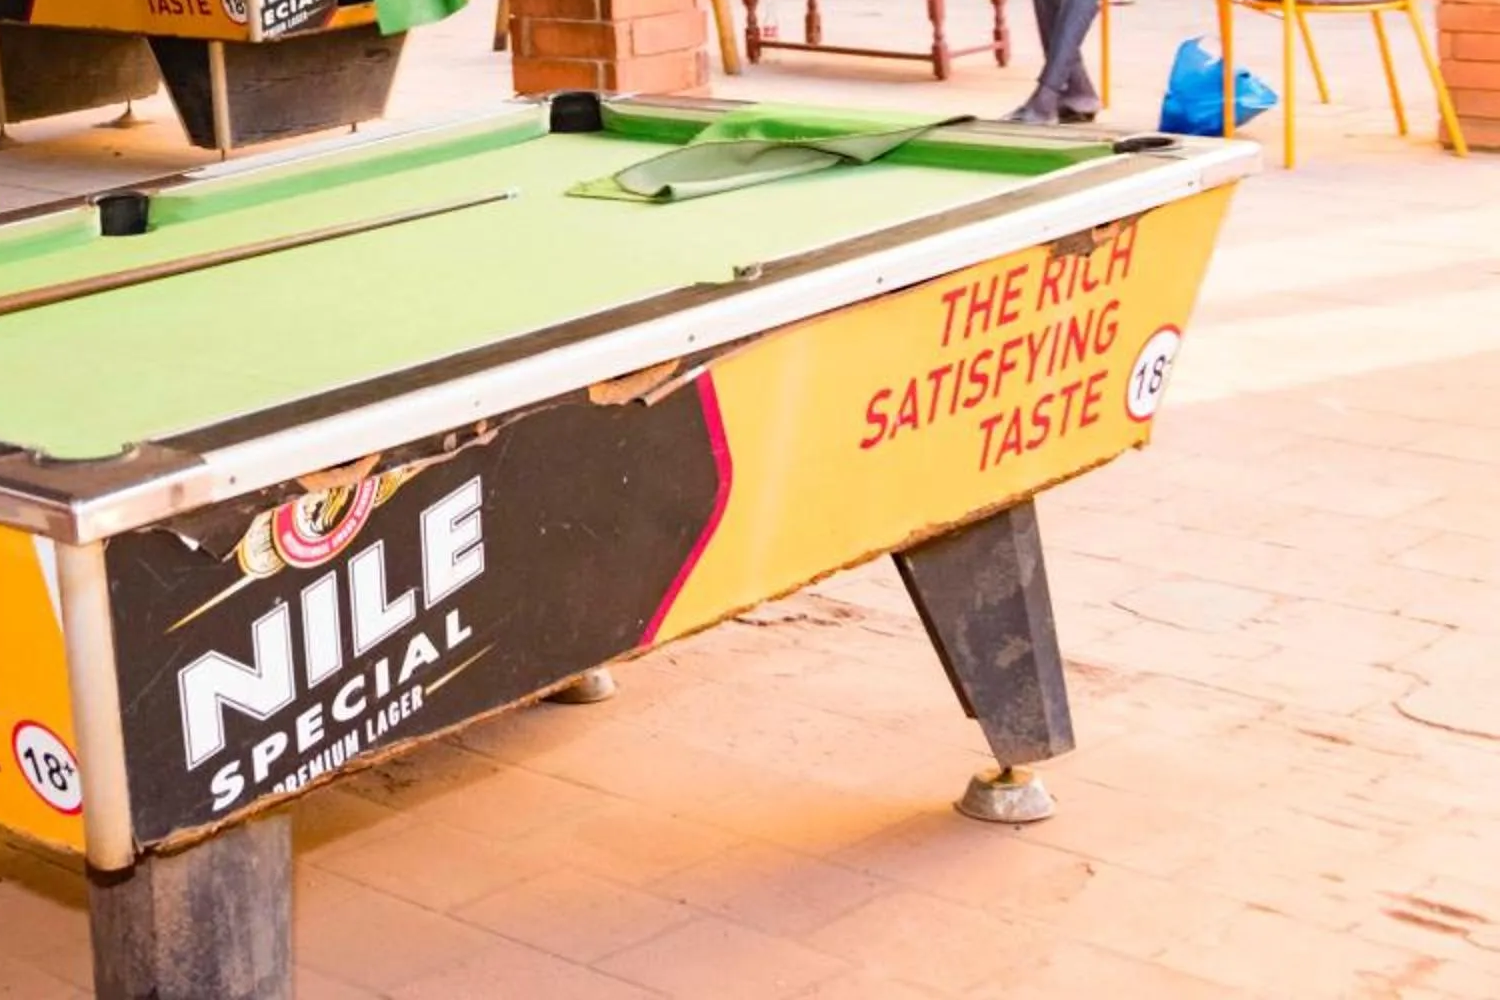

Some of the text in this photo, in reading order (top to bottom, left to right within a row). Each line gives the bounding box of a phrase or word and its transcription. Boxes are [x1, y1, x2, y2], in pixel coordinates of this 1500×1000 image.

[940, 217, 1138, 347] THE RICH
[858, 300, 1120, 450] SATISFYING
[978, 370, 1109, 472] TASTE
[177, 474, 485, 772] NILE
[23, 746, 75, 792] 18+
[210, 608, 474, 812] SPECIAL
[366, 685, 424, 743] LAGER
